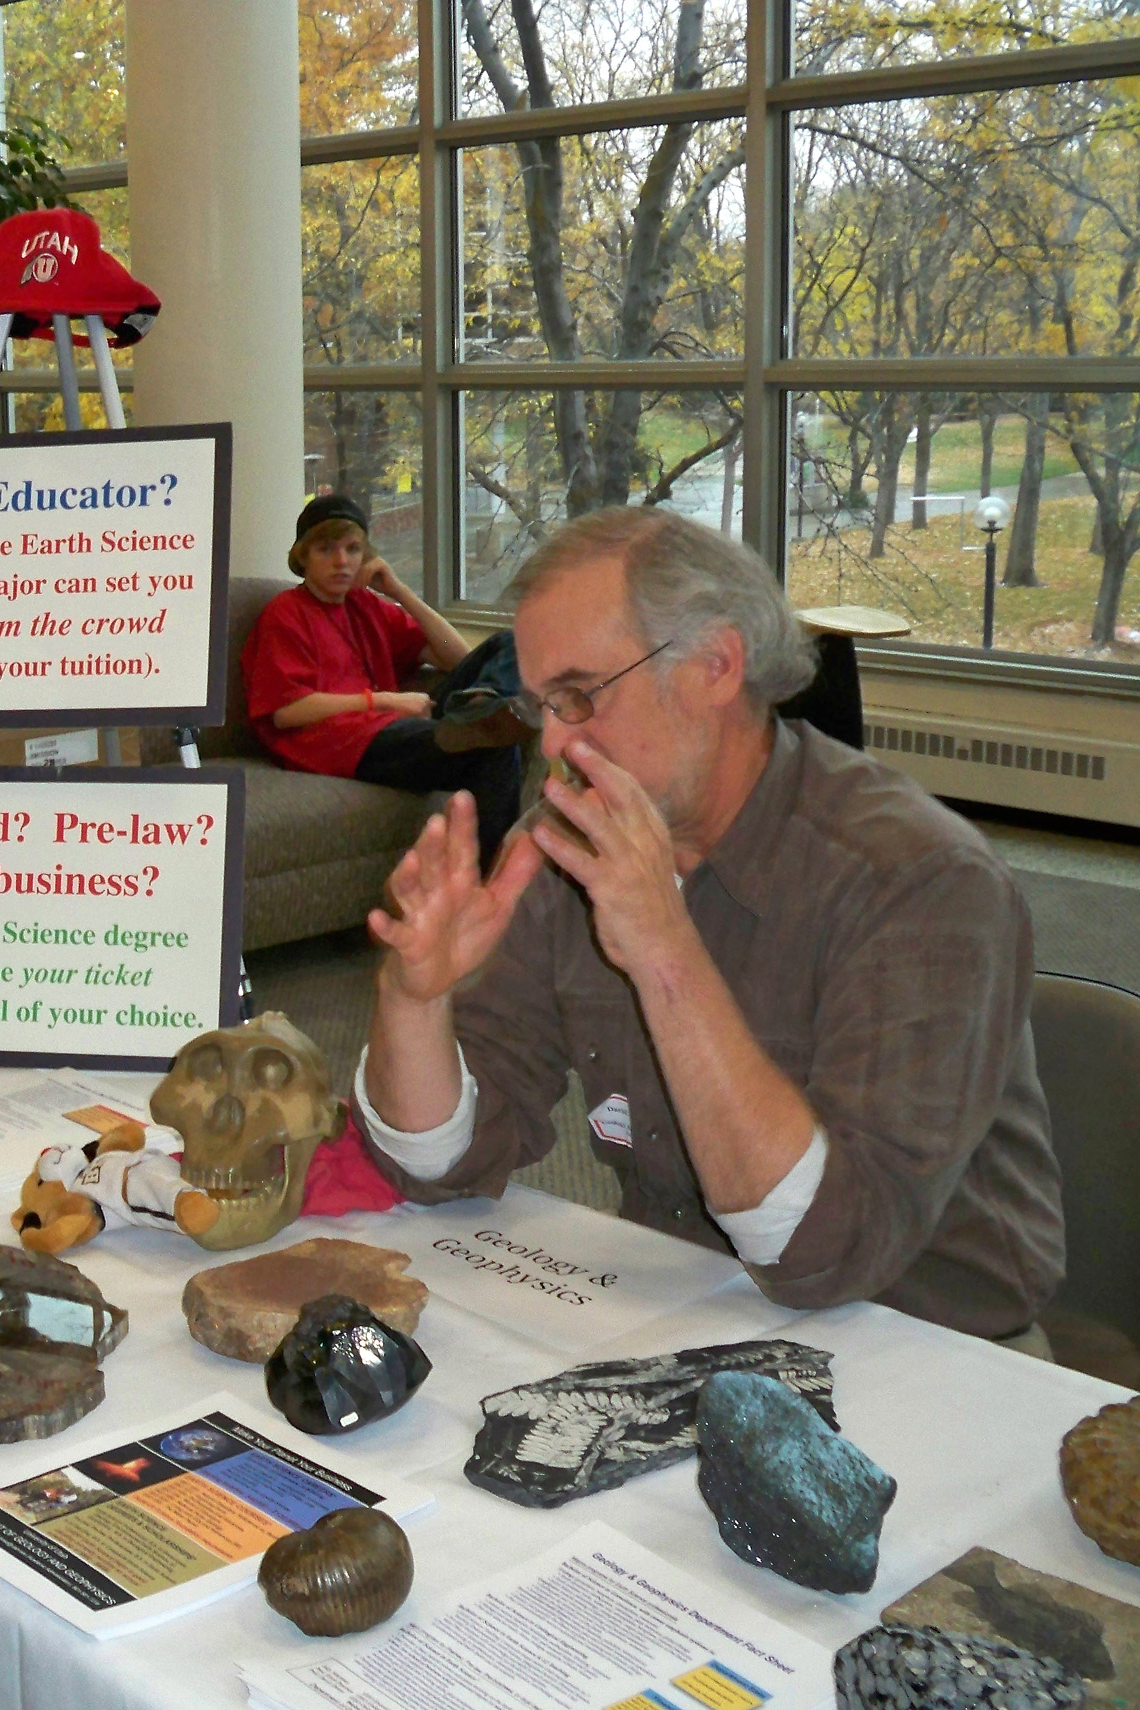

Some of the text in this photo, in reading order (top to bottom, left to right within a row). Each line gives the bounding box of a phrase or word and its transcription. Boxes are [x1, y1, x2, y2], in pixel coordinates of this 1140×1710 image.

[21, 231, 79, 265] UTAH
[21, 532, 92, 556] Earth
[100, 529, 195, 552] Science
[54, 576, 97, 594] can
[105, 572, 140, 592] set
[149, 574, 194, 595] you
[31, 612, 71, 637] the
[81, 609, 166, 634] crowd
[60, 653, 160, 678] tuition).
[54, 813, 214, 846] Pre-law?
[3, 922, 95, 946] Science
[104, 925, 189, 952] degree
[19, 966, 77, 988] your
[85, 963, 152, 987] ticket
[17, 1000, 40, 1022] of
[48, 1006, 108, 1029] your
[116, 1004, 203, 1028] choice.
[433, 1238, 592, 1306] Geophysics
[474, 1230, 618, 1288] Geology &
[315, 1470, 353, 1491] Business
[13, 1535, 51, 1559] GEOLOGY
[49, 1558, 67, 1571] AND
[65, 1569, 117, 1605] GEOPHYSICS
[592, 1552, 628, 1576] Geology
[636, 1579, 689, 1612] Geophysics
[689, 1610, 744, 1644] Department
[743, 1642, 766, 1657] Fact
[765, 1656, 795, 1675] Sheet
